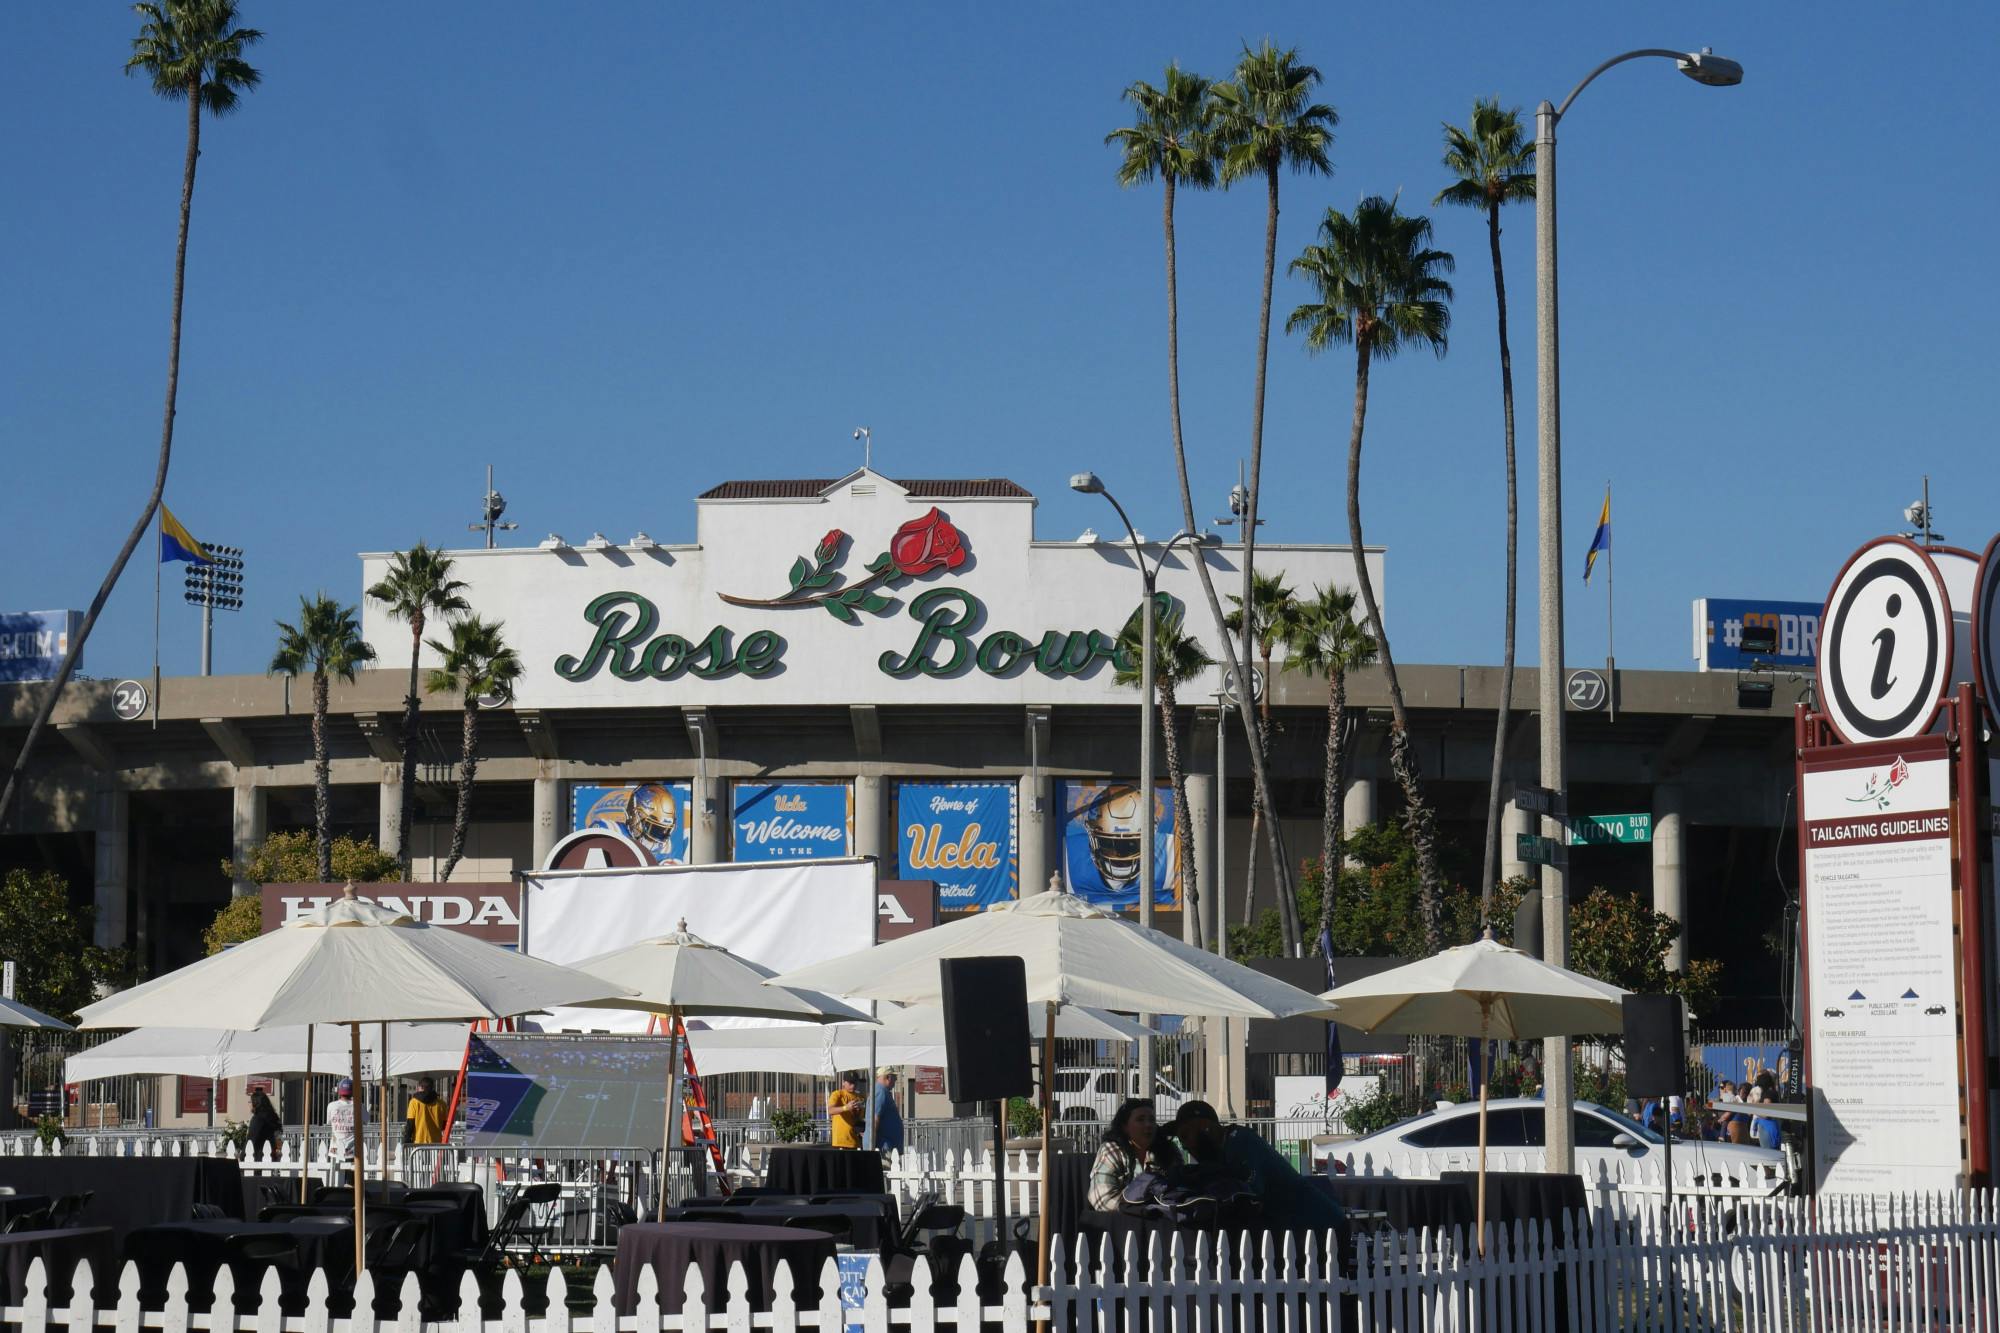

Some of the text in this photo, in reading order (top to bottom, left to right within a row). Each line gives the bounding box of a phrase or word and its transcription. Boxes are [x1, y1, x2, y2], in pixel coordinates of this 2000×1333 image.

[554, 591, 778, 678] Rose
[116, 690, 142, 711] 24
[1571, 679, 1600, 700] 27
[930, 796, 979, 815] Home of
[738, 816, 842, 845] Welcome
[1573, 820, 1624, 843] Arroyo
[1629, 816, 1648, 828] BLVD
[1811, 817, 1949, 841] TAILGATING GUIDELINES
[769, 847, 813, 855] TO THE
[906, 823, 1000, 870] Ucla
[280, 896, 520, 926] HNDA
[1290, 1105, 1323, 1119] Rose
